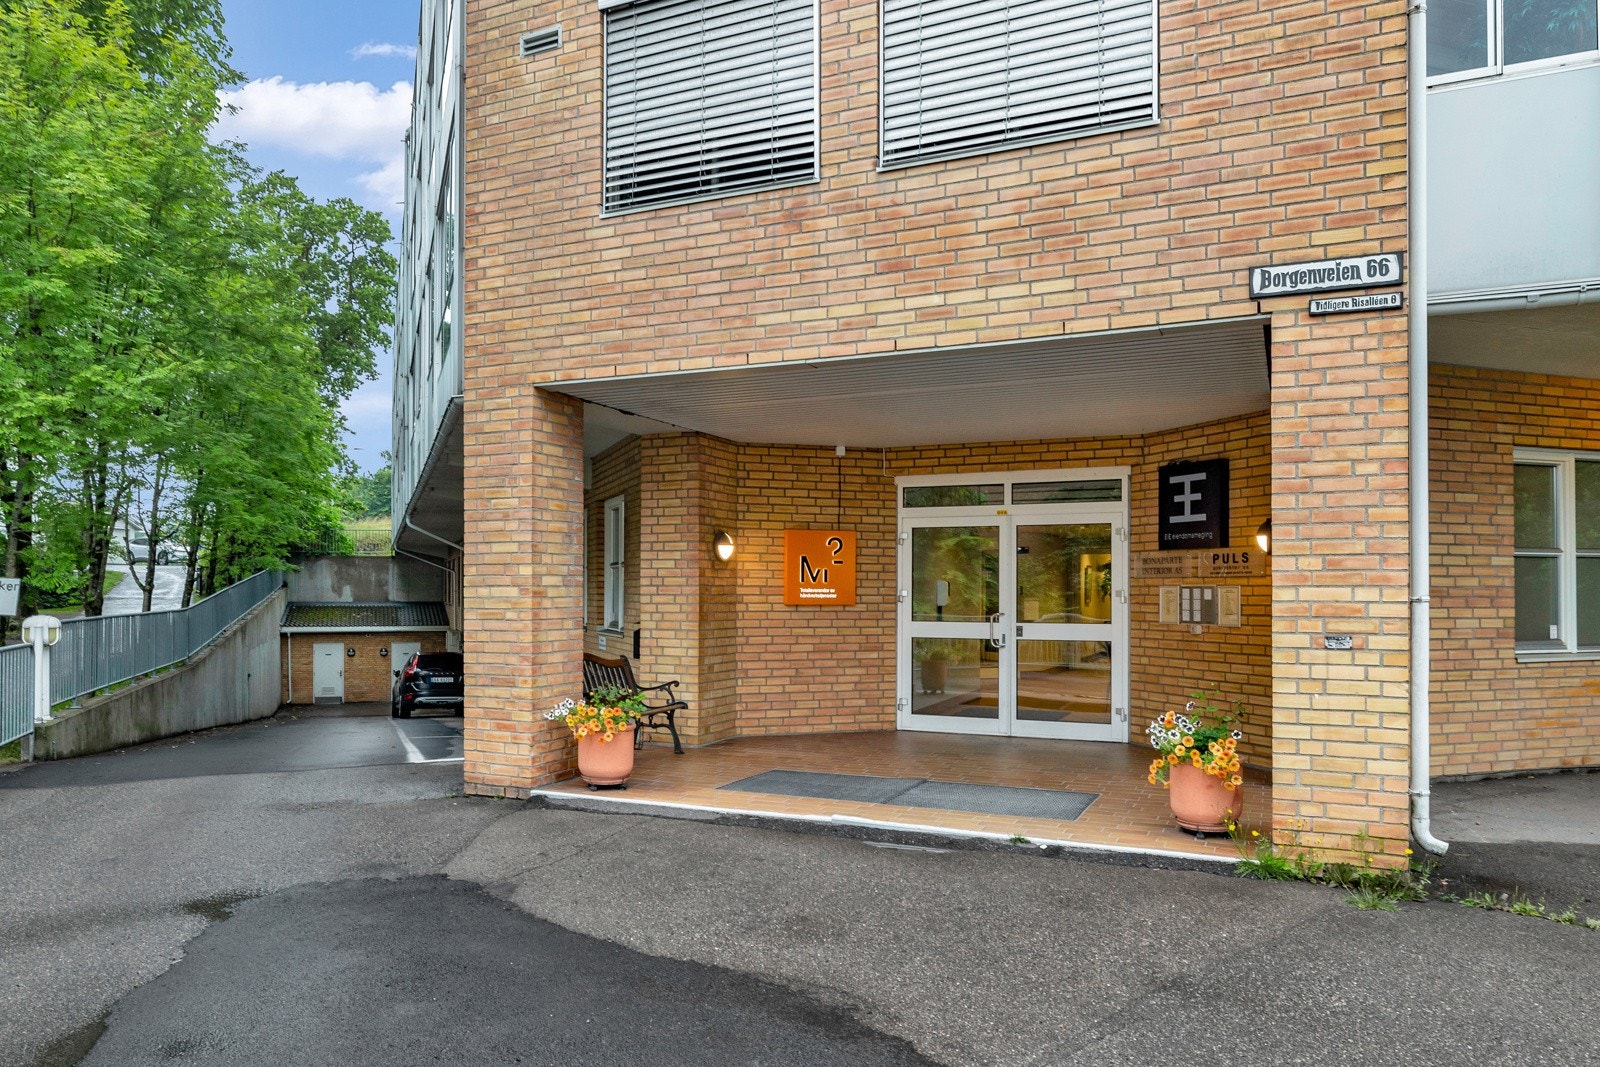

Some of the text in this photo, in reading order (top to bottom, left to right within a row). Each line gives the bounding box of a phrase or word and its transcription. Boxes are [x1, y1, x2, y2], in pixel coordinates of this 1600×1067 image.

[1260, 258, 1391, 291] Borgenveien 66
[1212, 552, 1249, 565] PULS
